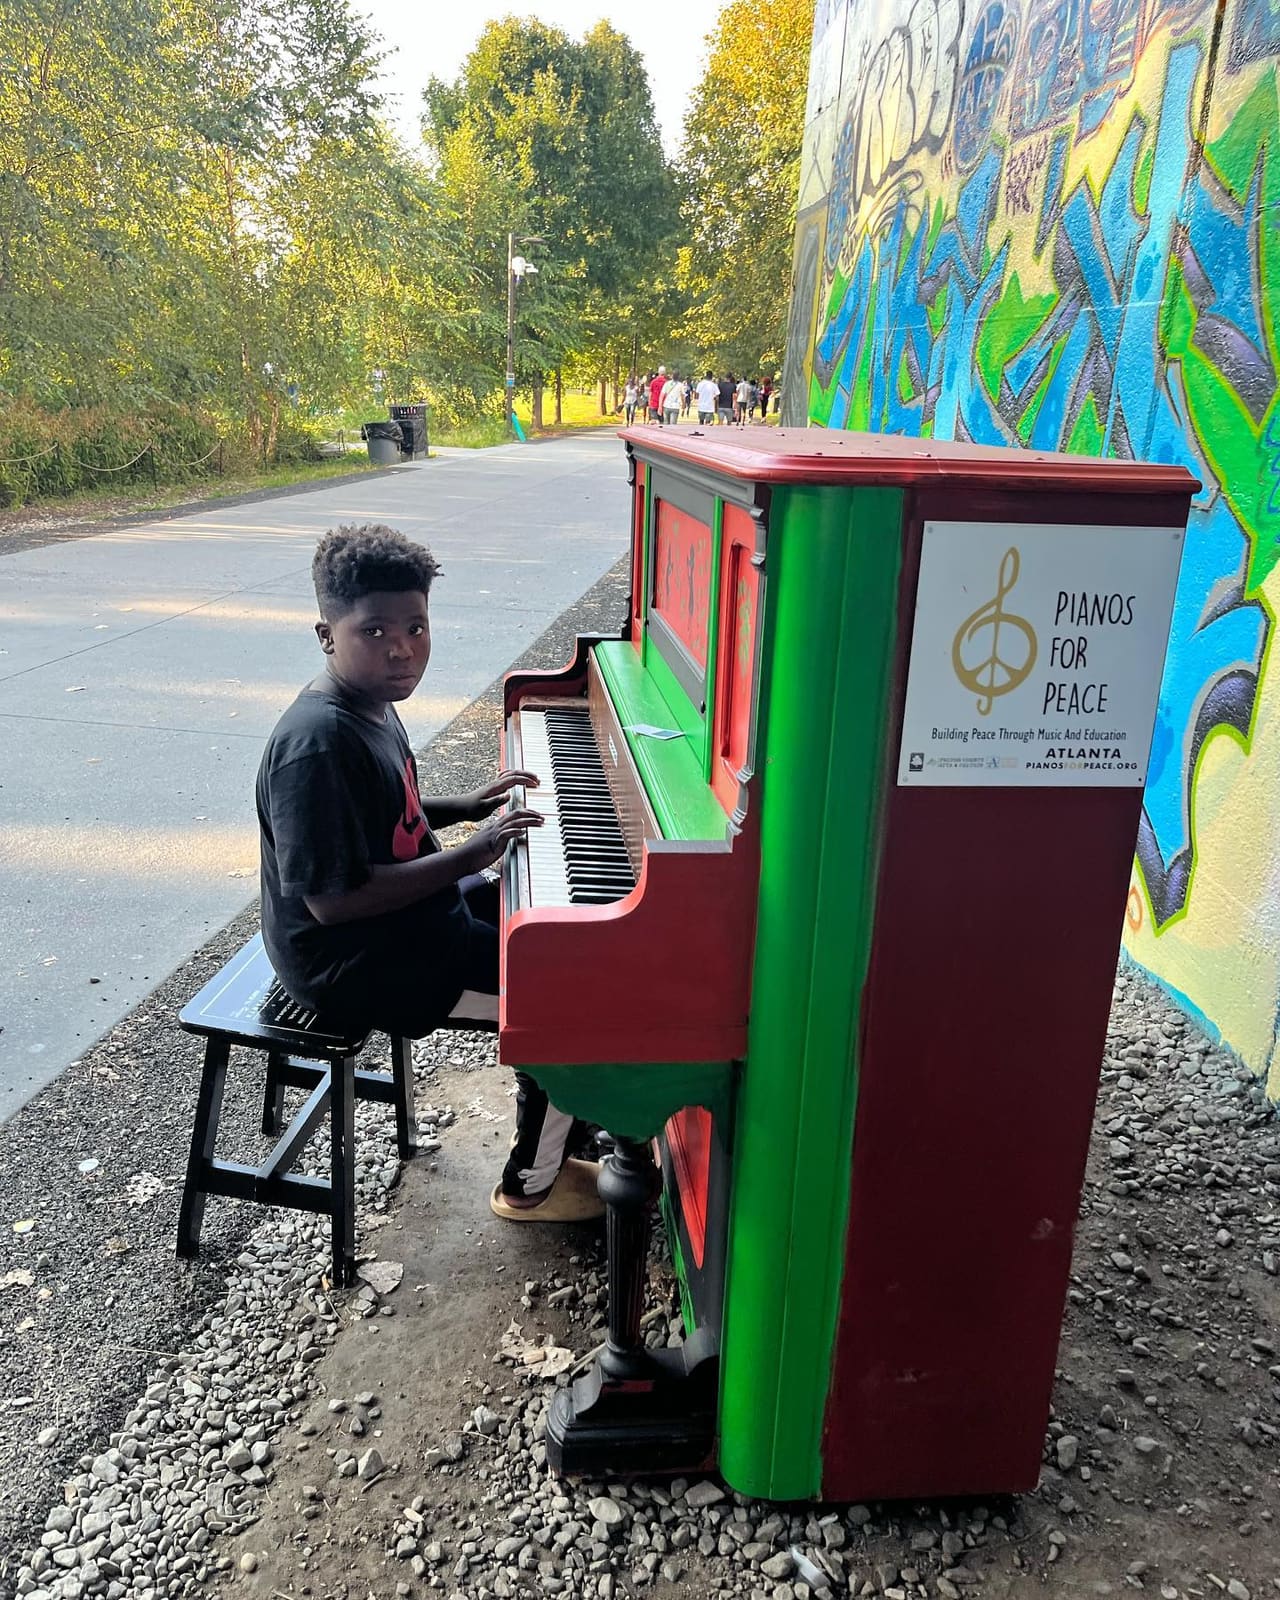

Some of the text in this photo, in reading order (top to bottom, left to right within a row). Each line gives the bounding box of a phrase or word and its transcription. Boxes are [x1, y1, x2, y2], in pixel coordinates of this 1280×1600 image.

[1054, 591, 1136, 626] PIANOS
[1050, 636, 1088, 670] FOR
[1042, 682, 1108, 715] PEACE
[931, 727, 1127, 743] Building Peace Through Music And Education
[1045, 748, 1121, 759] ATLANTA
